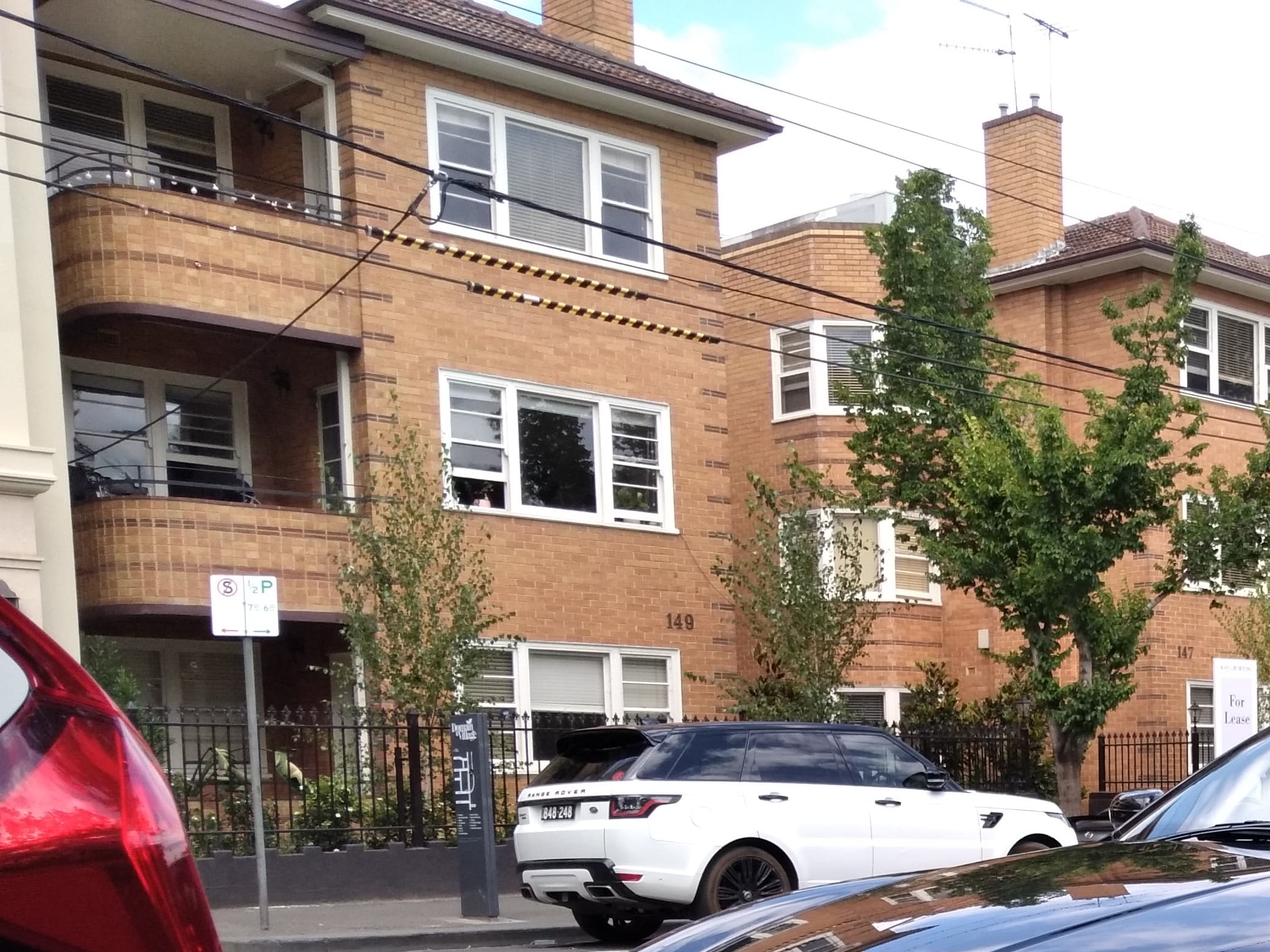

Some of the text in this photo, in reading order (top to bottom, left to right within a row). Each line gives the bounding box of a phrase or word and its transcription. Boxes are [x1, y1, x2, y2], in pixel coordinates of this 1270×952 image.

[666, 612, 694, 631] 149
[1177, 645, 1194, 659] 147
[1229, 694, 1245, 708] For
[1224, 711, 1250, 725] Lease
[555, 788, 586, 796] ROVER
